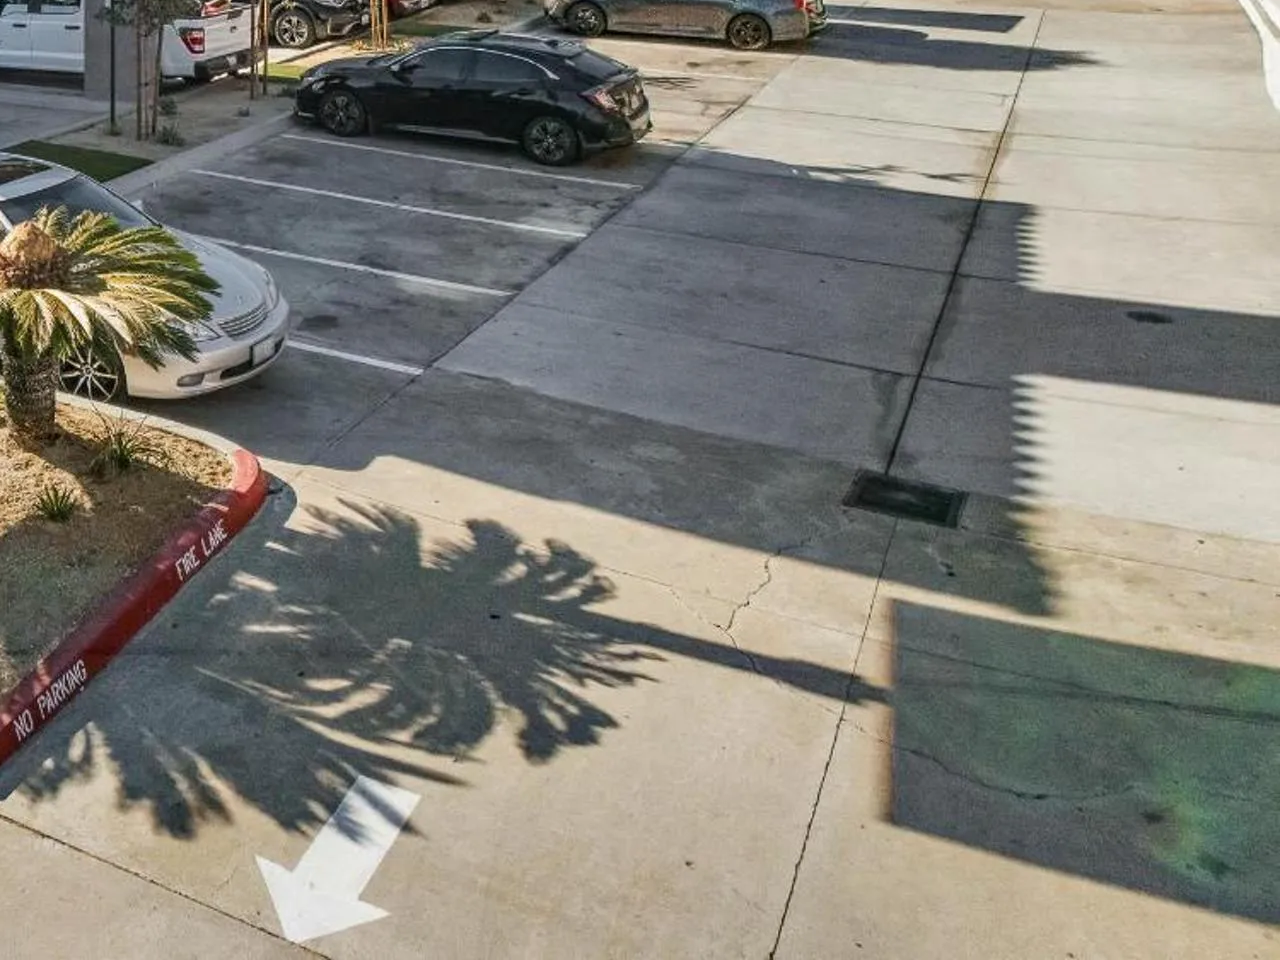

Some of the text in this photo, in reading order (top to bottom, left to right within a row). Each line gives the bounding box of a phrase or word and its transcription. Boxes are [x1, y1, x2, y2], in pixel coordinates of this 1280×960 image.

[175, 519, 228, 581] FIRE LANE
[13, 659, 87, 741] NO PARKING
